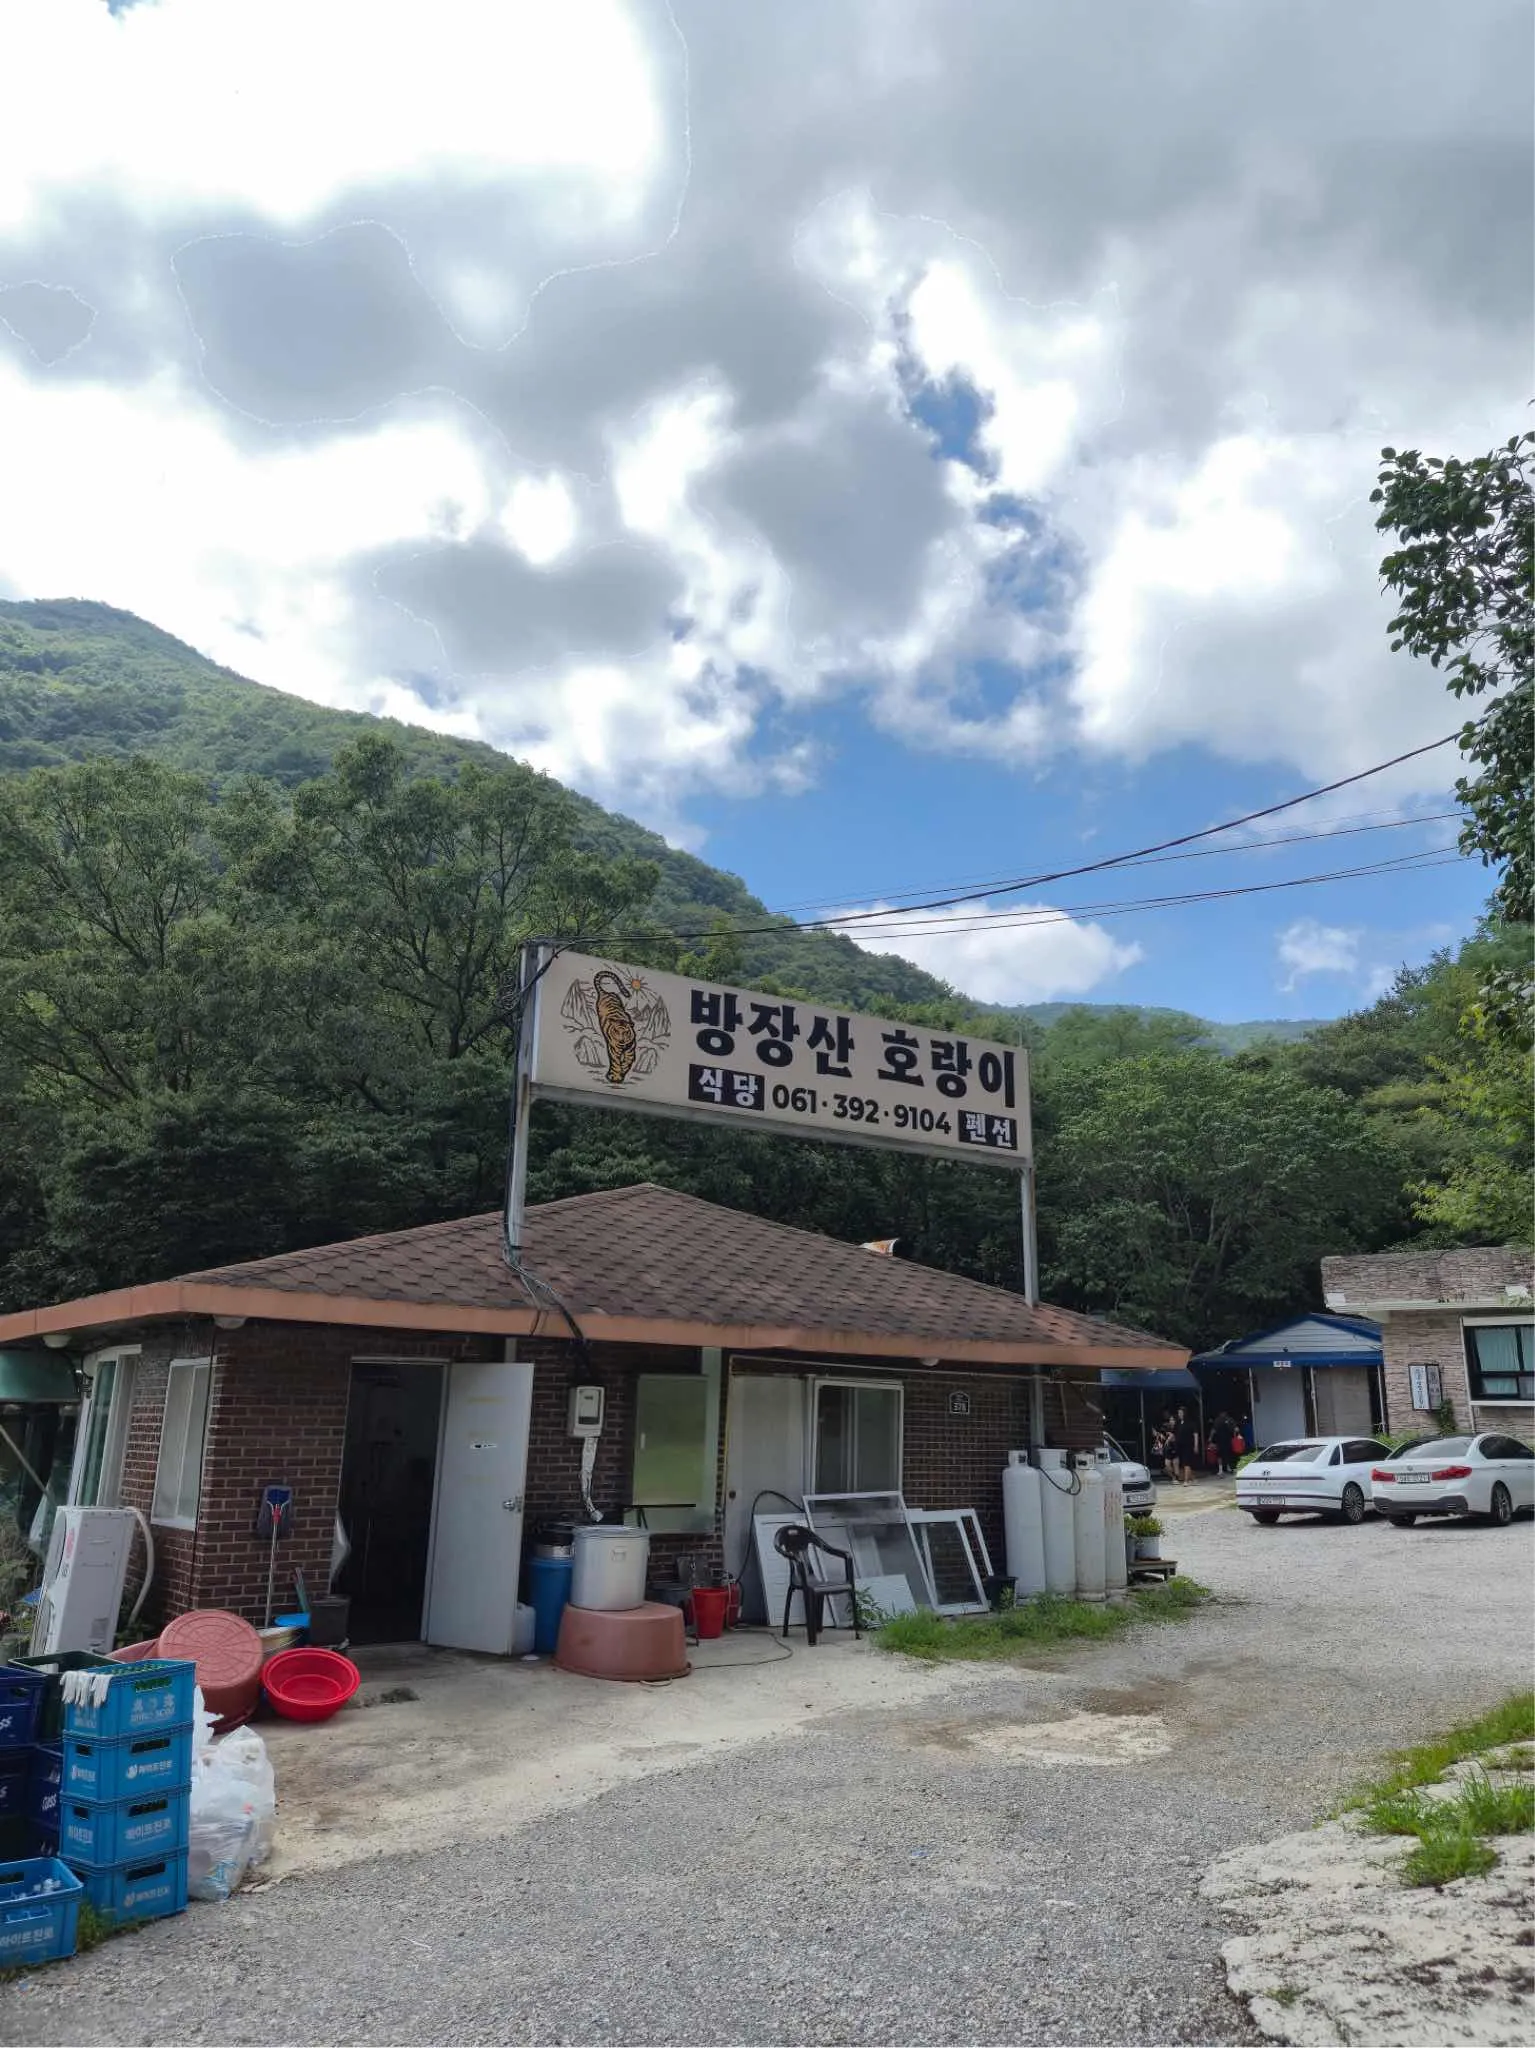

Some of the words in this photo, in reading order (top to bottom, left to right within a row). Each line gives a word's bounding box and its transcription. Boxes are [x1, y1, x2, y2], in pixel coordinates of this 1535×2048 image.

[691, 989, 855, 1078] 방장산
[877, 1029, 1016, 1108] 호랑이
[698, 1068, 759, 1107] 식당
